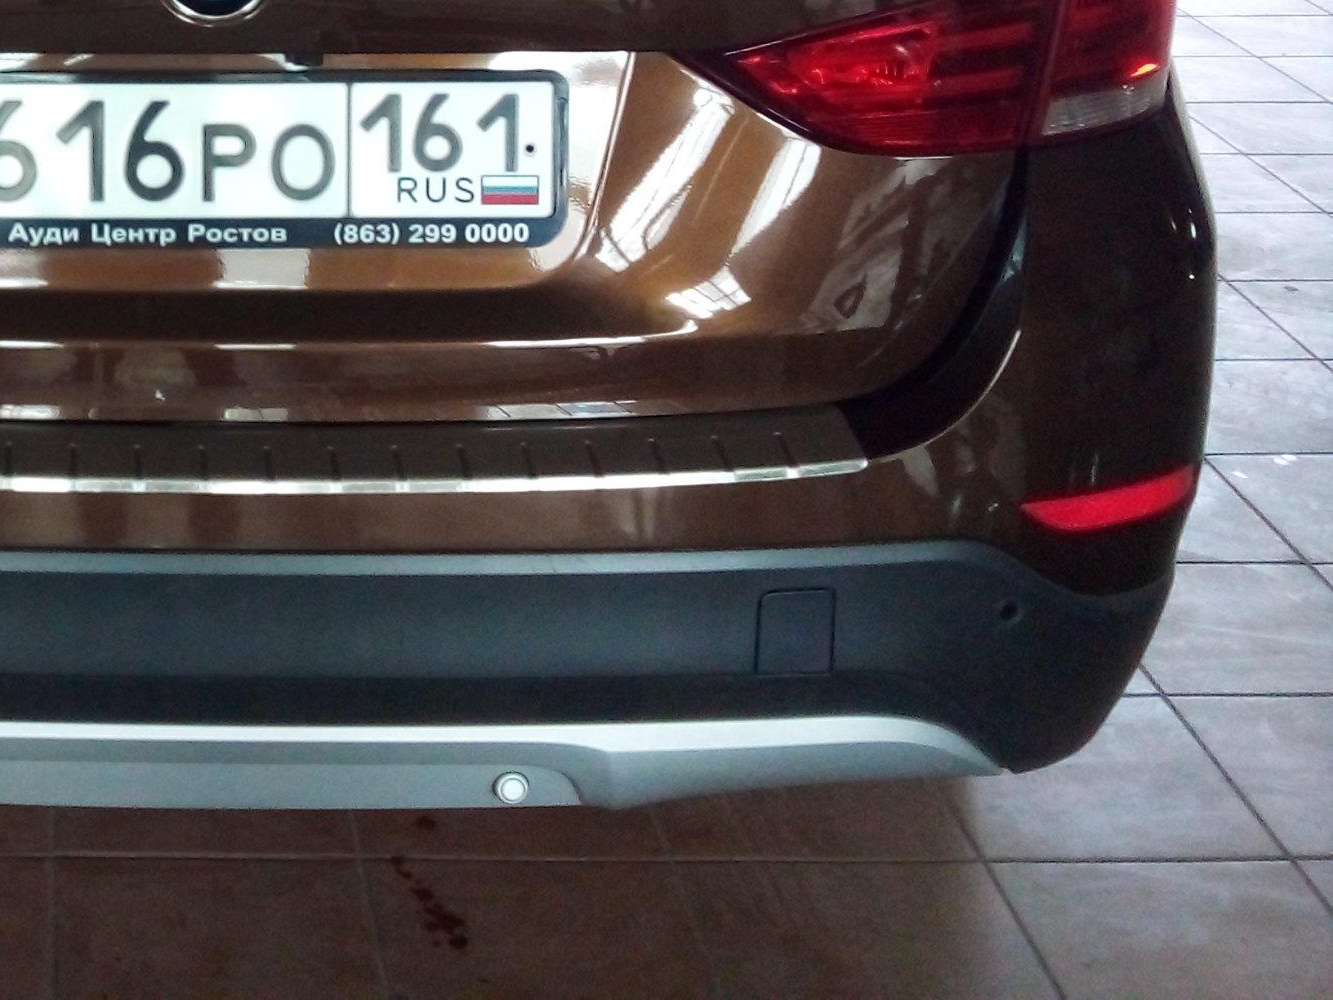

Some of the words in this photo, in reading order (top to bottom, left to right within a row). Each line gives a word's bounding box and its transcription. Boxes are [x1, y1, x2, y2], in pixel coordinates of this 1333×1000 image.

[359, 94, 521, 174] 161
[397, 176, 475, 205] RUS
[8, 222, 79, 246] Ауди
[91, 223, 177, 247] Центр
[187, 223, 288, 244] Ростов
[333, 222, 400, 245] (863)
[408, 222, 457, 244] 299
[465, 222, 530, 244] 0000
